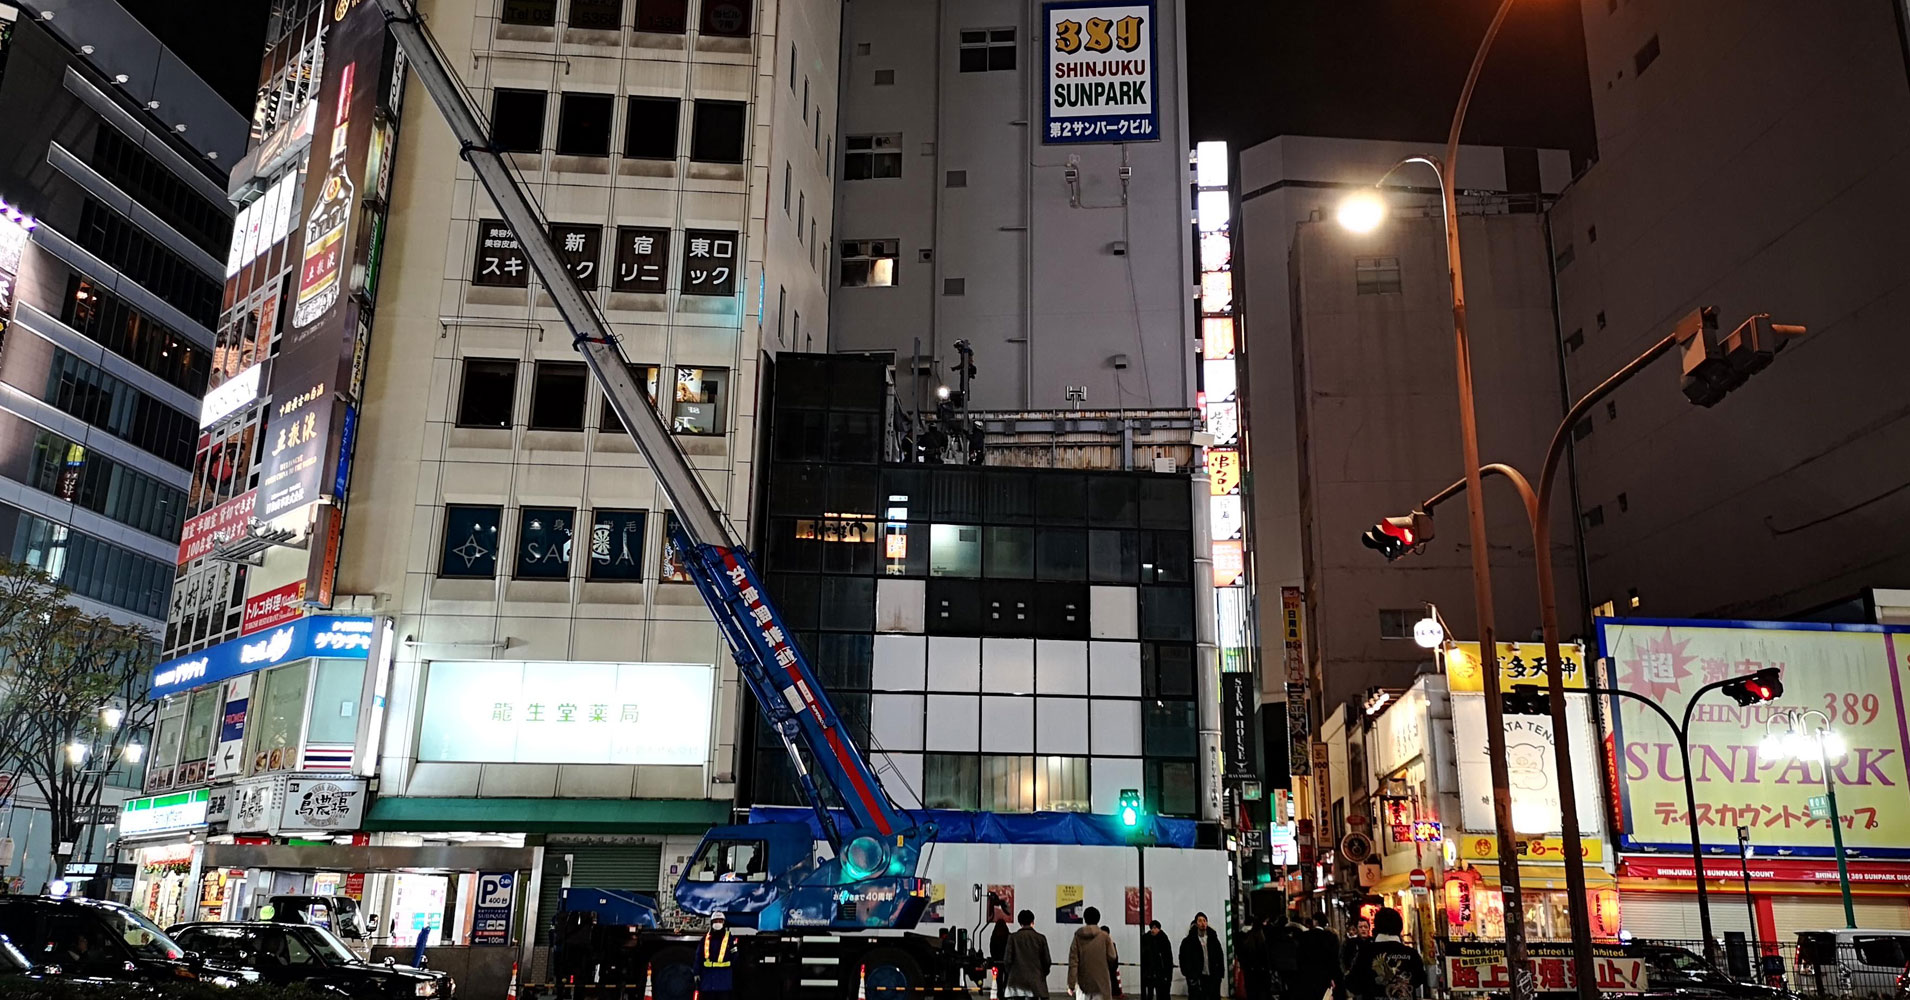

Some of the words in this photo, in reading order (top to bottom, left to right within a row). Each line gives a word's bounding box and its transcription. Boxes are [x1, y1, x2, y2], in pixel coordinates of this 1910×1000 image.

[1055, 15, 1145, 55] 389
[1055, 60, 1145, 79] SHINJUKU
[1054, 81, 1147, 107] SUNPARK
[689, 238, 732, 259] 東口
[621, 263, 660, 282] リニ
[690, 267, 730, 285] ック
[245, 592, 282, 620] トルコ料理
[1641, 651, 1676, 684] 超
[491, 702, 640, 724] 龍生堂薬局
[1821, 692, 1880, 726] 389
[1625, 741, 1896, 786] SUNPARK
[1657, 868, 1693, 877] SHINJUKU
[1707, 870, 1739, 878] SUNPARK
[481, 880, 498, 904] P
[1538, 948, 1565, 956] street
